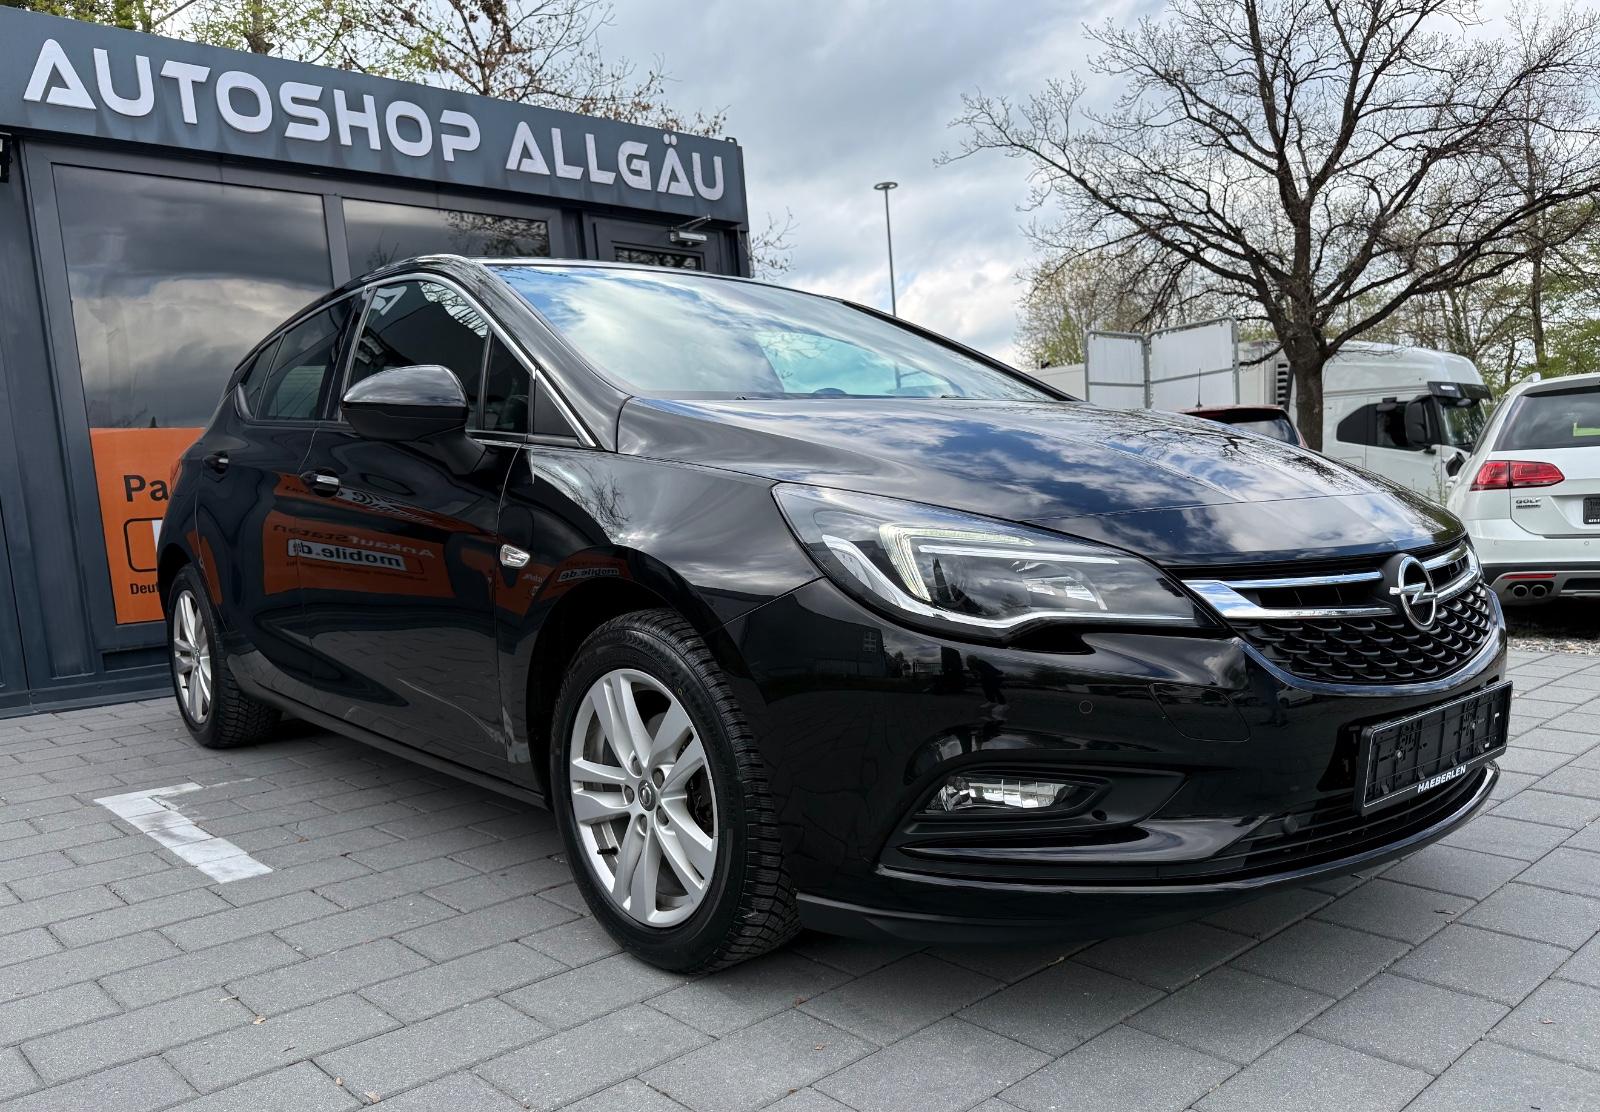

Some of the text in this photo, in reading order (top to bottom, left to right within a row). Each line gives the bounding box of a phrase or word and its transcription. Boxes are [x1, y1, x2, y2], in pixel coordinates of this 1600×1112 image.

[23, 39, 725, 201] AUTOSHOP ALLGÄU
[123, 474, 169, 502] Pa
[1515, 497, 1542, 505] GOLF
[1417, 764, 1467, 794] HAEBERLEN
